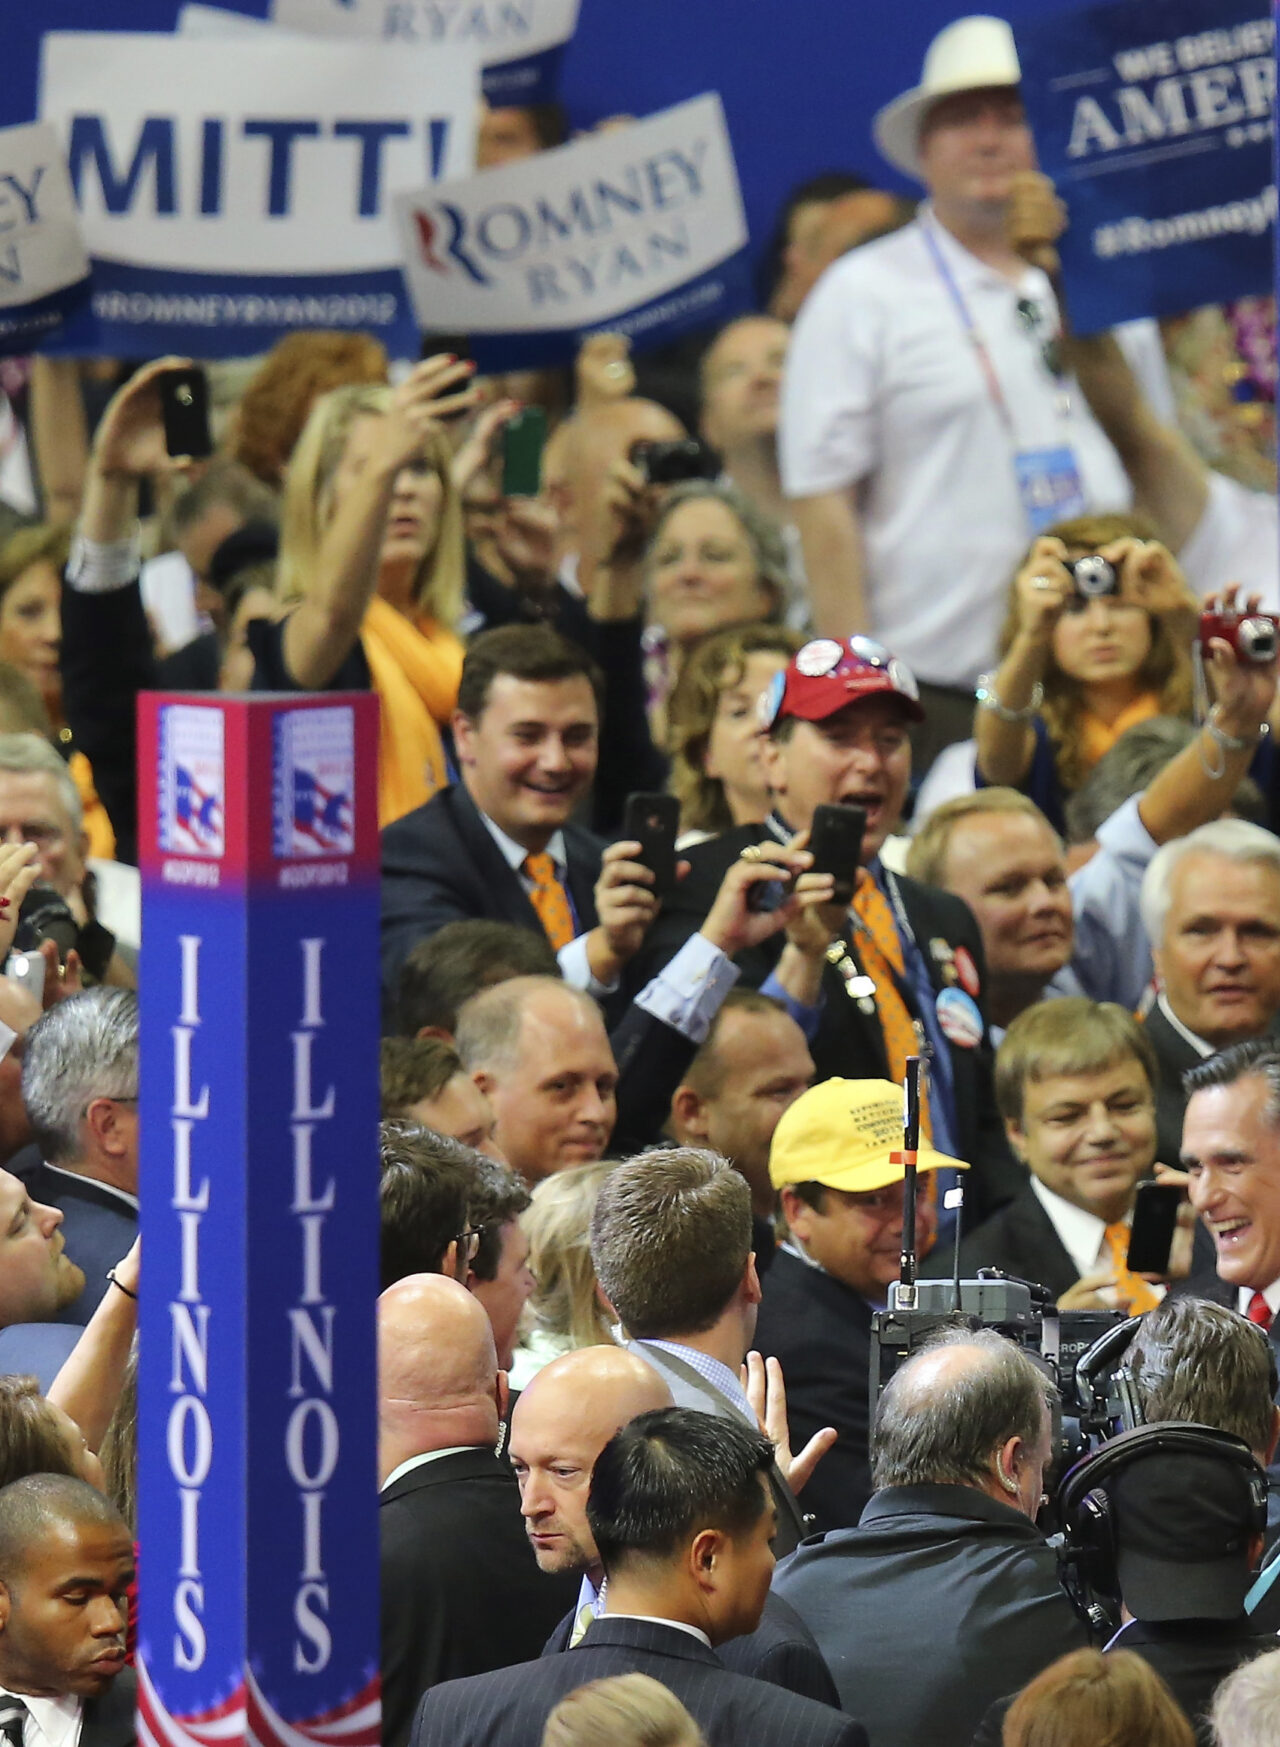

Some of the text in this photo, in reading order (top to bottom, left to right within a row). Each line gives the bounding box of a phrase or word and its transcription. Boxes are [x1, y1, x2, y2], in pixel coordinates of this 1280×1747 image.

[410, 137, 706, 288] ROMNEY
[526, 221, 690, 308] RYAN
[168, 936, 212, 1673] ILLINOIS
[285, 938, 339, 1673] ILLINOIS
